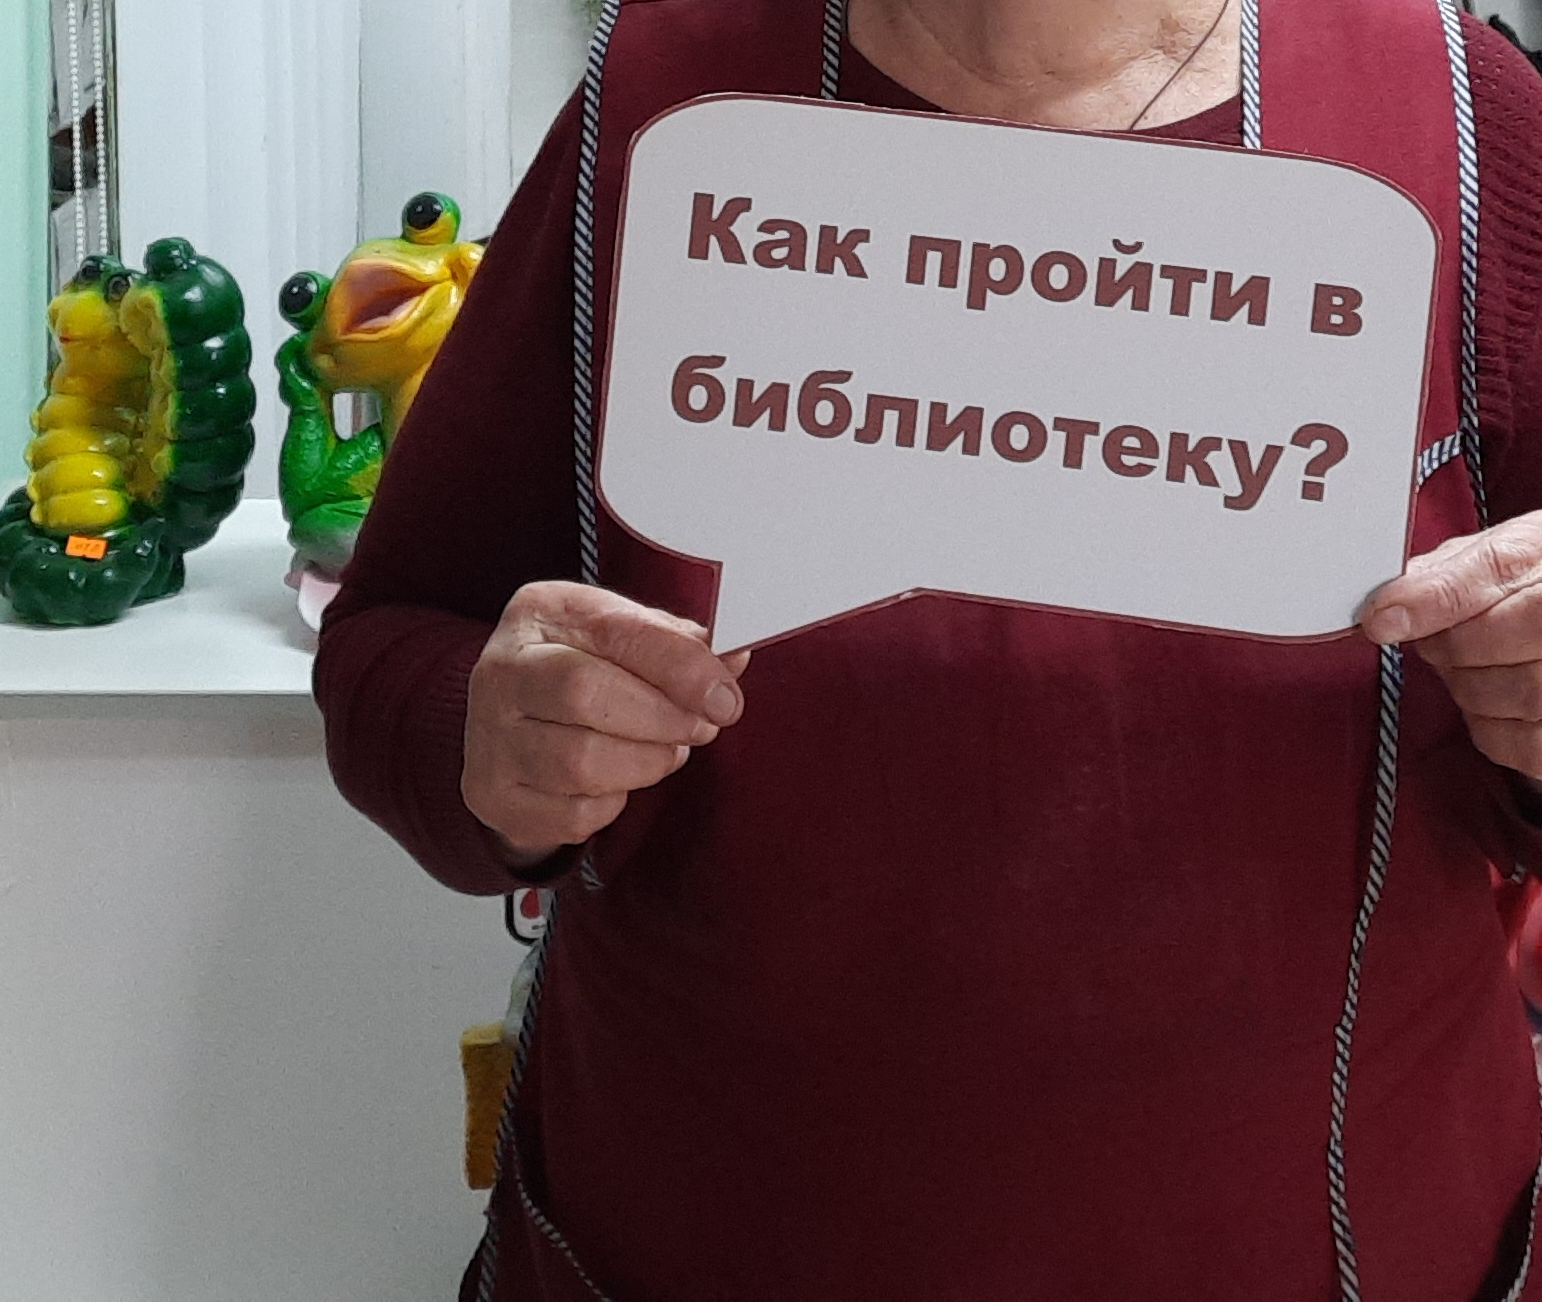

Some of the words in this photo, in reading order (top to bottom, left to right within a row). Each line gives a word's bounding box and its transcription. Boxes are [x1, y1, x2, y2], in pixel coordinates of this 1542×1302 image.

[687, 191, 871, 280] Как
[904, 234, 1272, 328] пройти
[1310, 281, 1364, 338] в
[669, 354, 1350, 512] библиотеку?
